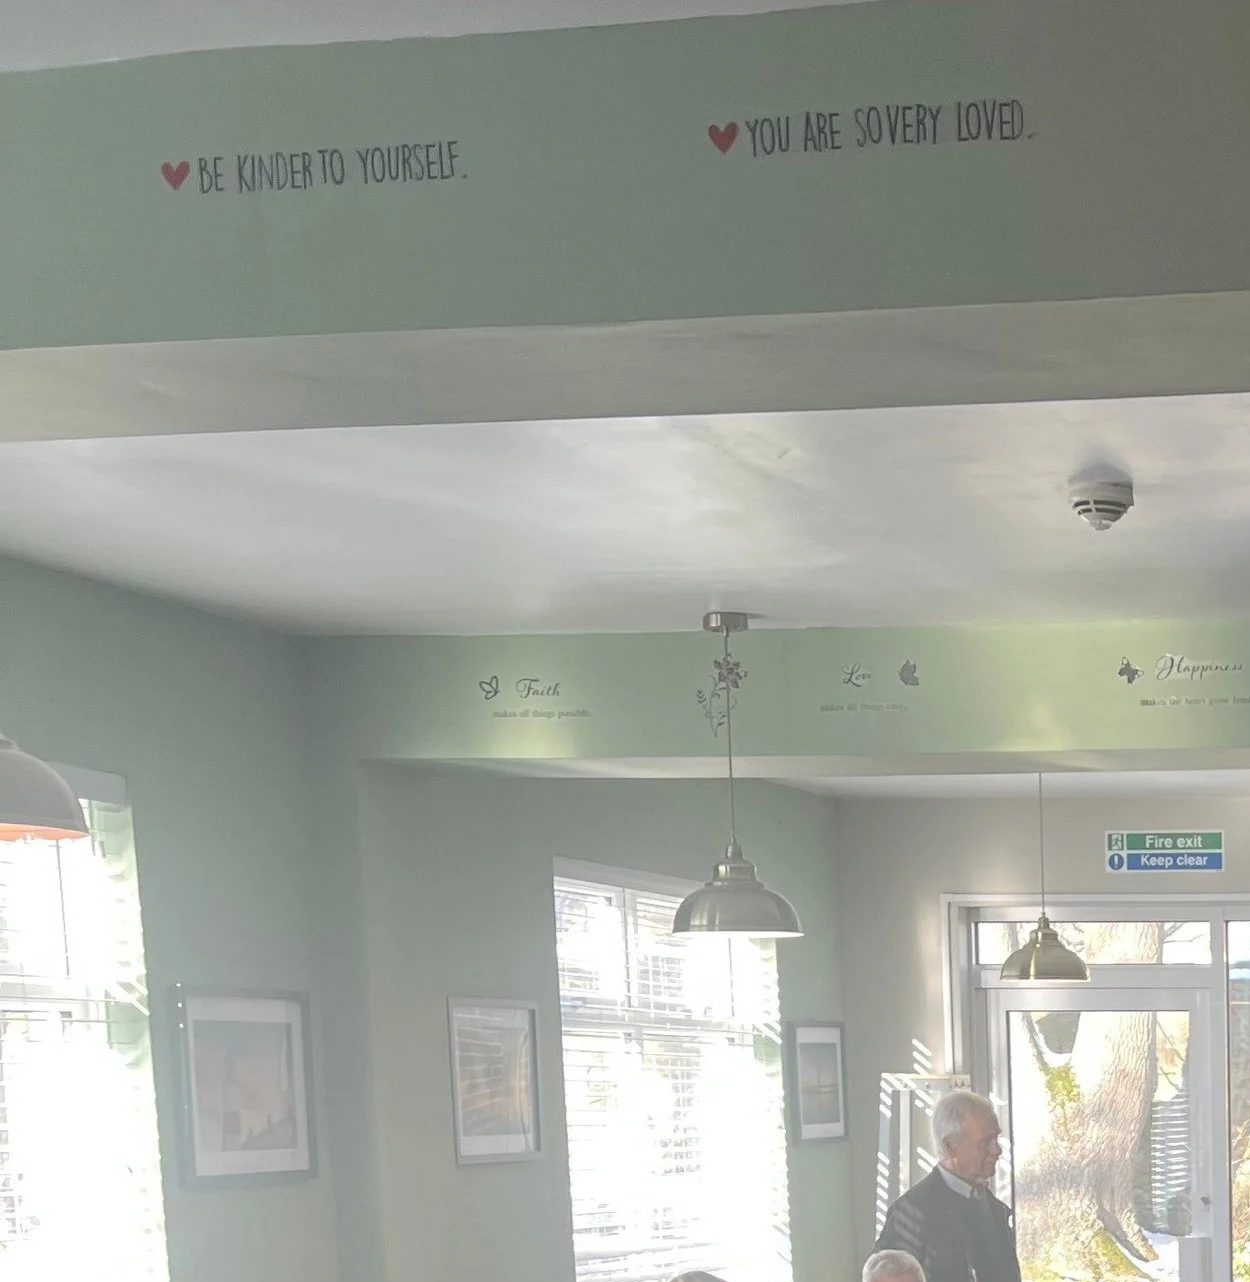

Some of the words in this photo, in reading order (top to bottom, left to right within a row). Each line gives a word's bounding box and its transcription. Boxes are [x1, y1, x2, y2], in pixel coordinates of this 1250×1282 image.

[746, 115, 790, 157] YOU
[804, 112, 842, 152] ARE
[854, 107, 882, 147] SO
[886, 103, 943, 144] VERY
[957, 100, 1032, 141] LOVED.
[199, 156, 225, 194] BE
[237, 152, 313, 193] KINDER
[318, 149, 345, 185] TO
[358, 141, 467, 184] YOURSELF.
[841, 663, 872, 687] Love
[1155, 656, 1243, 680] Happiness
[516, 678, 560, 699] Faith
[1145, 835, 1174, 848] Fire
[1176, 834, 1203, 848] exit
[1140, 855, 1174, 868] Keep
[1176, 854, 1209, 866] clear
